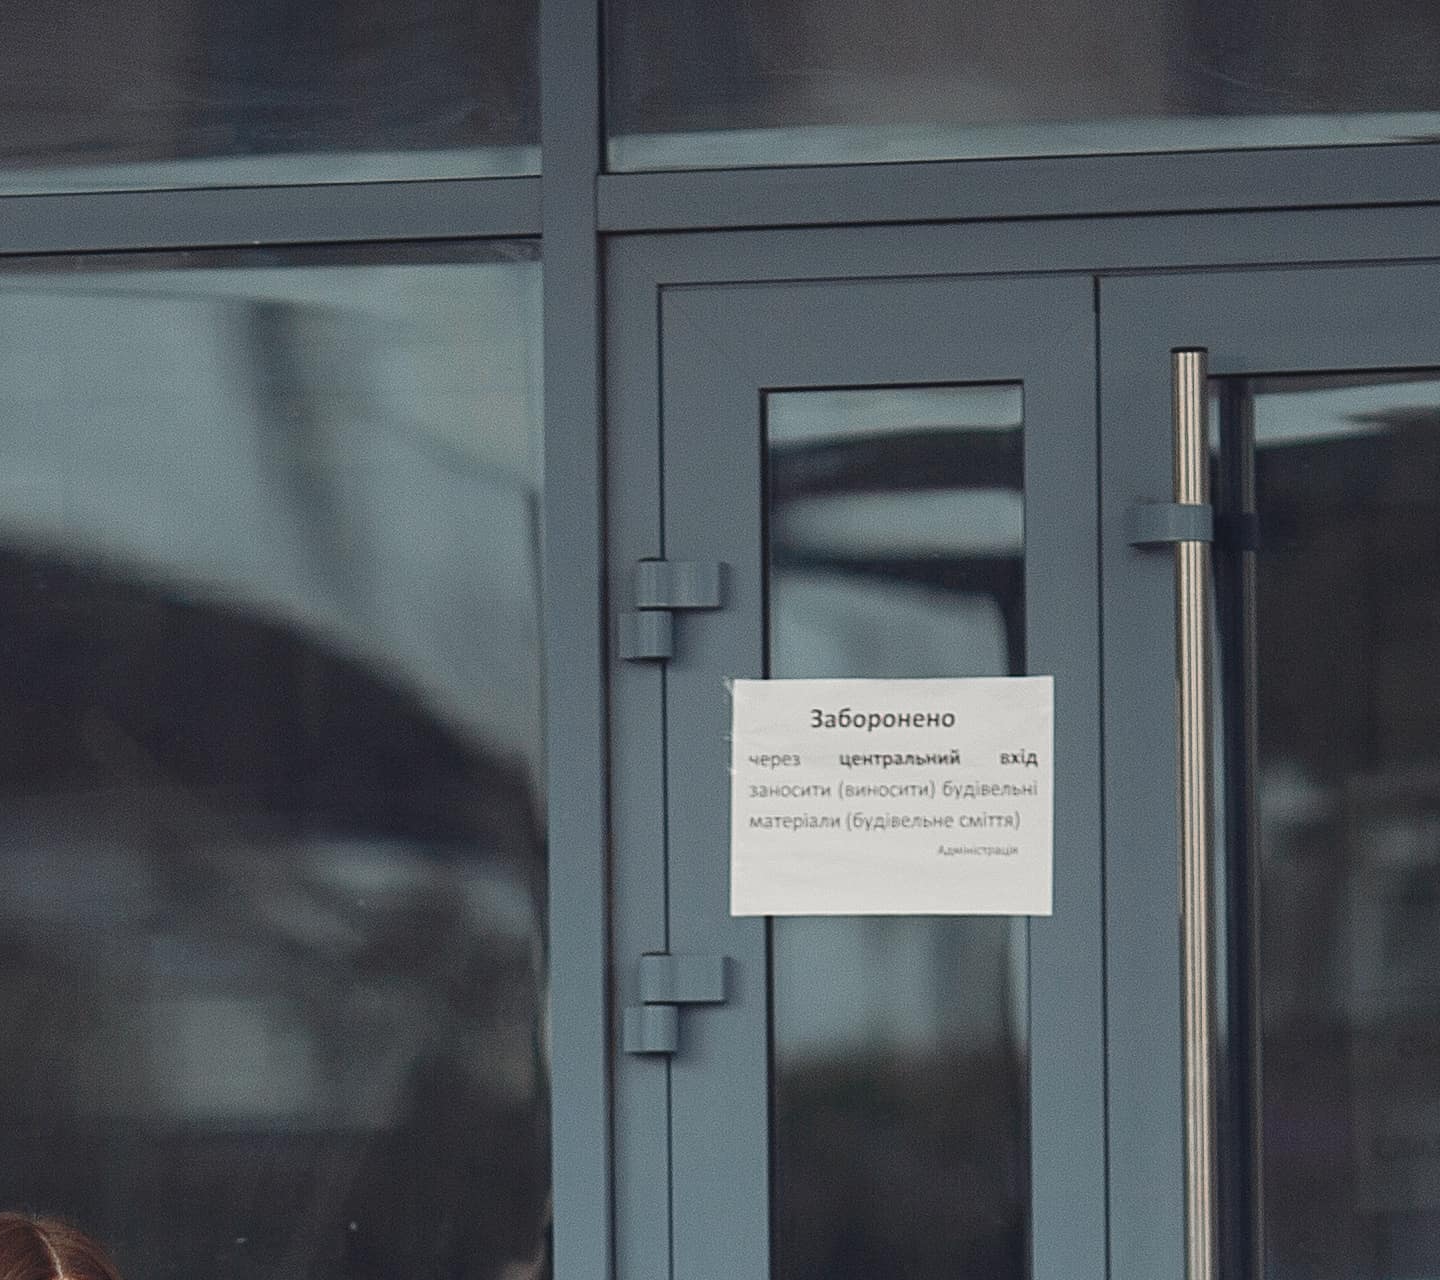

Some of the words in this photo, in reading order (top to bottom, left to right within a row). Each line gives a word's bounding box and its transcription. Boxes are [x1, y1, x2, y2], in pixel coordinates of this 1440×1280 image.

[810, 706, 956, 732] Заборонено
[748, 753, 802, 771] через
[838, 748, 961, 769] центральний
[999, 747, 1039, 768] вхід
[748, 783, 831, 799] заносити
[838, 780, 936, 800] (виносити)
[941, 780, 1039, 800] будівельні
[748, 811, 841, 832] матеріали
[845, 811, 955, 832] (будівельне
[958, 810, 1021, 831] сміття)
